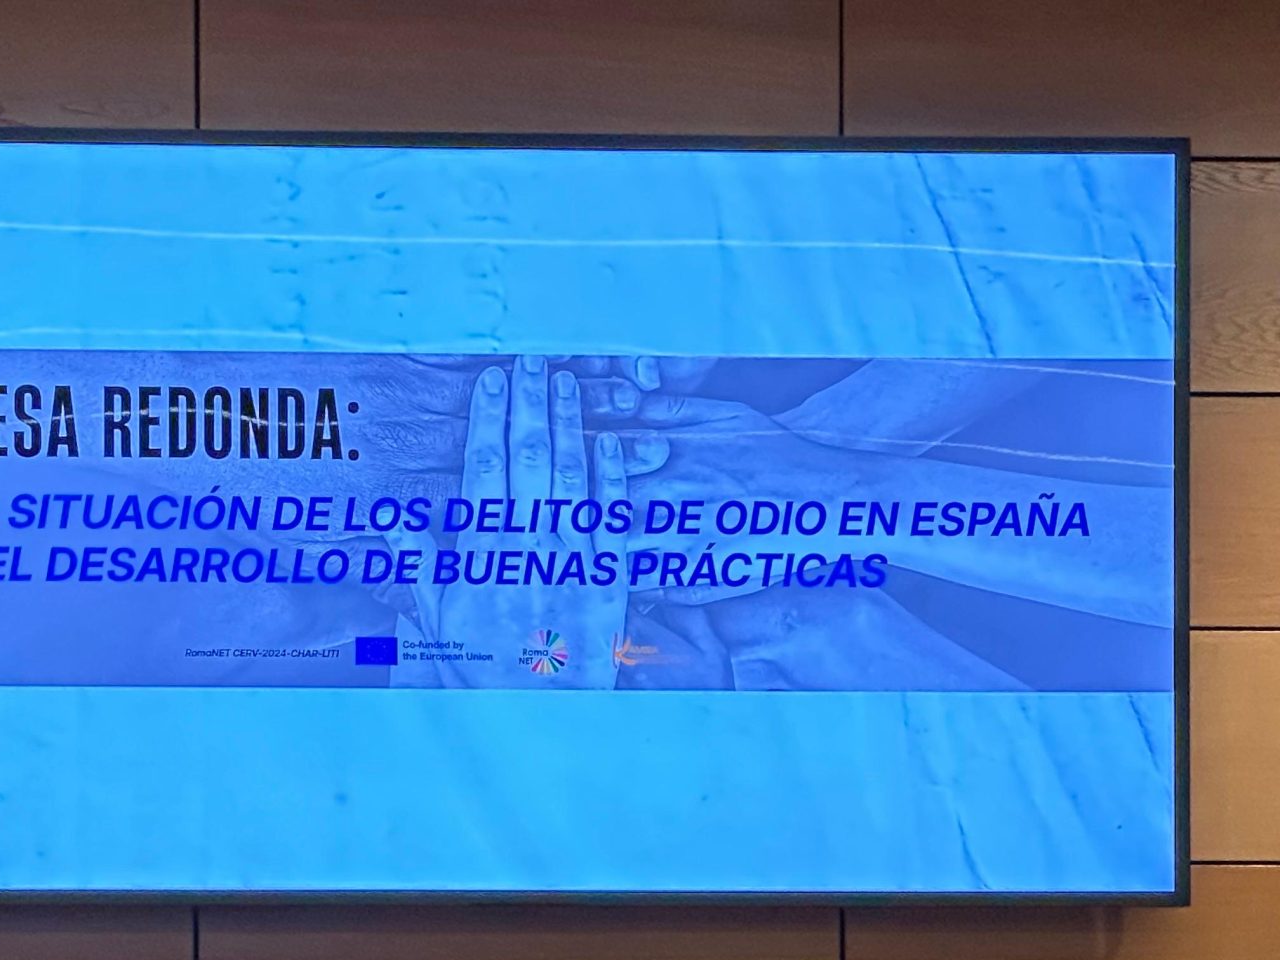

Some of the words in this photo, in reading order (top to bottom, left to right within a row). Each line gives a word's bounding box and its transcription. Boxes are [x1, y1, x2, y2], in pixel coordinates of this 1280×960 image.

[104, 386, 361, 460] REDONDA:
[7, 485, 262, 531] SITUACIÓN
[271, 496, 334, 531] DE
[342, 496, 432, 533] LOS
[441, 497, 634, 535] DELITOS
[643, 499, 706, 535] DE
[715, 500, 827, 536] ODIO
[837, 501, 900, 536] EN
[910, 492, 1091, 538] ESPAÑA
[45, 546, 350, 585] DESARROLLO
[361, 549, 423, 585] DE
[432, 549, 619, 587] BUENAS
[629, 542, 889, 589] PRÁCTICAS
[402, 640, 451, 649] Co-funded
[452, 641, 465, 651] by
[184, 648, 231, 658] RomaNET
[402, 652, 417, 661] the
[419, 652, 464, 663] European
[466, 652, 494, 661] Union
[522, 648, 549, 657] Roma
[518, 657, 534, 665] NET
